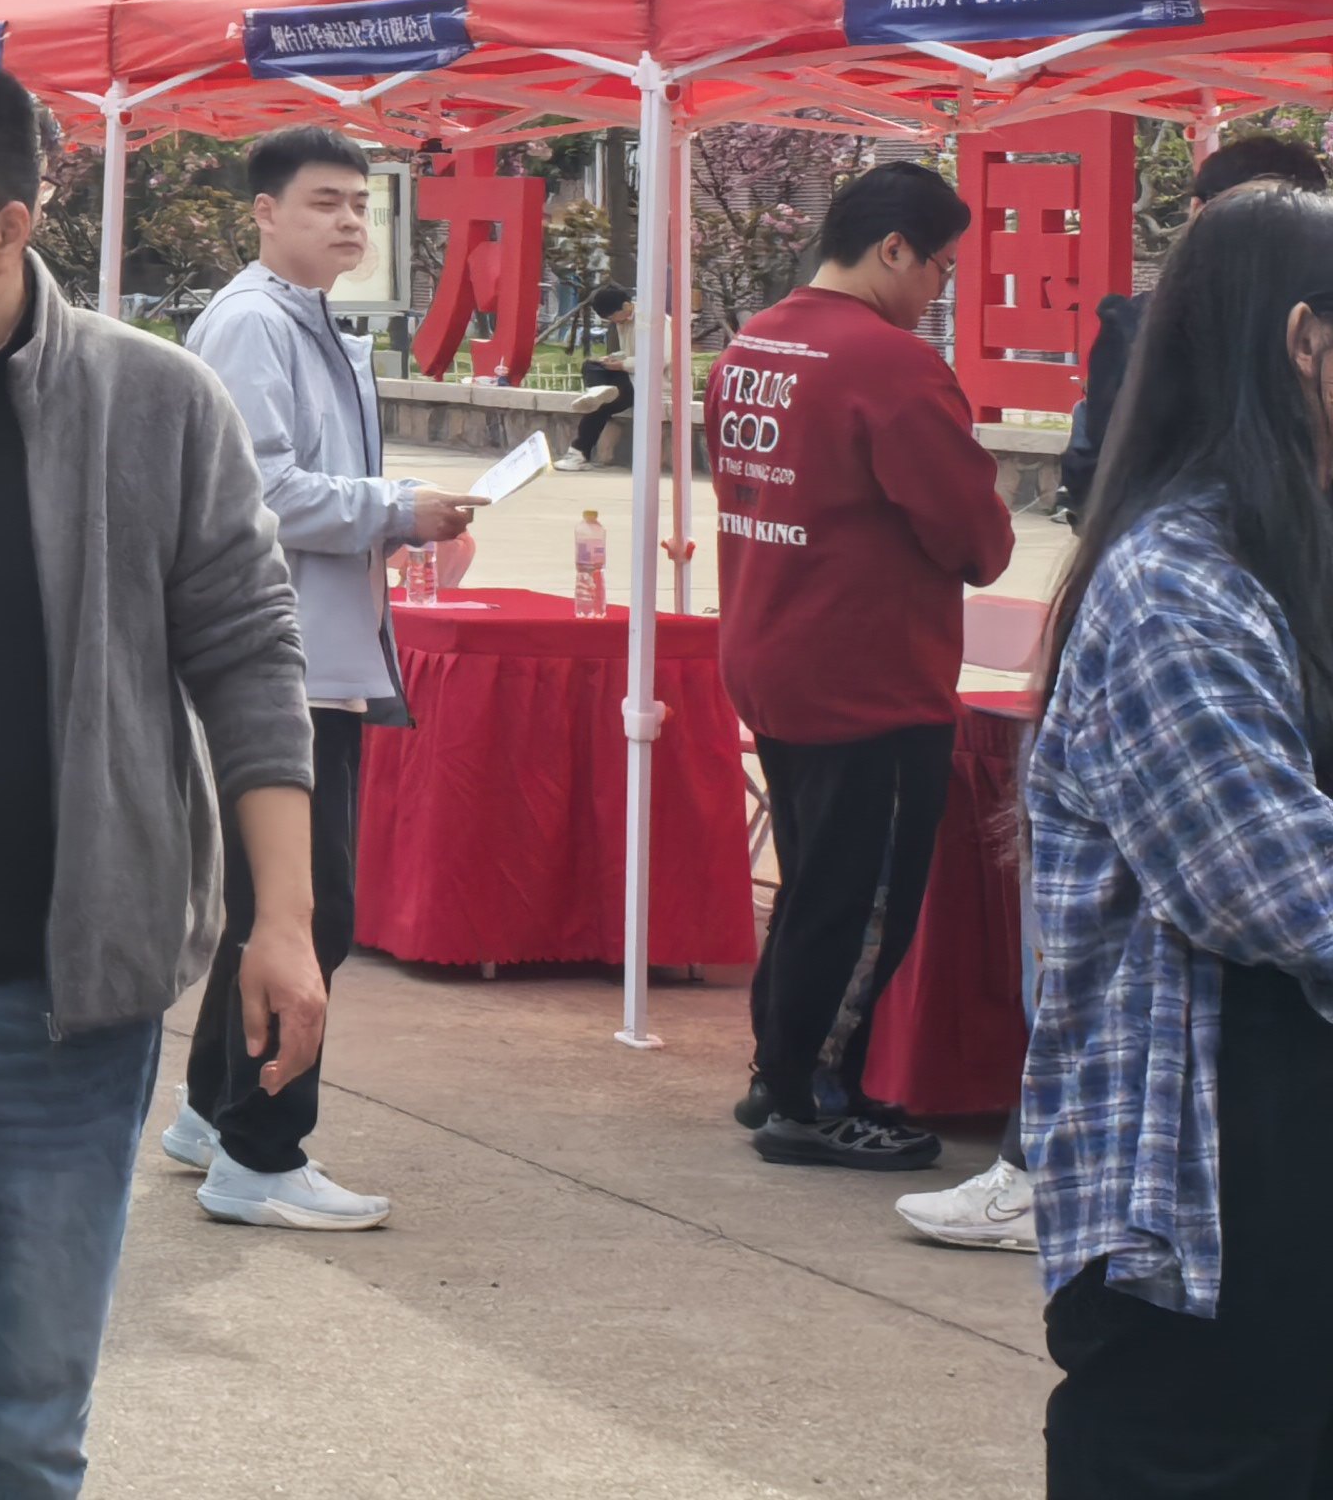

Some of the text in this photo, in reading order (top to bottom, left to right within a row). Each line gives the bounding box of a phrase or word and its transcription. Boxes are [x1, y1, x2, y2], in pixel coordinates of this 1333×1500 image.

[954, 109, 1137, 425] 国
[721, 411, 779, 453] GOD
[755, 520, 808, 546] KING
